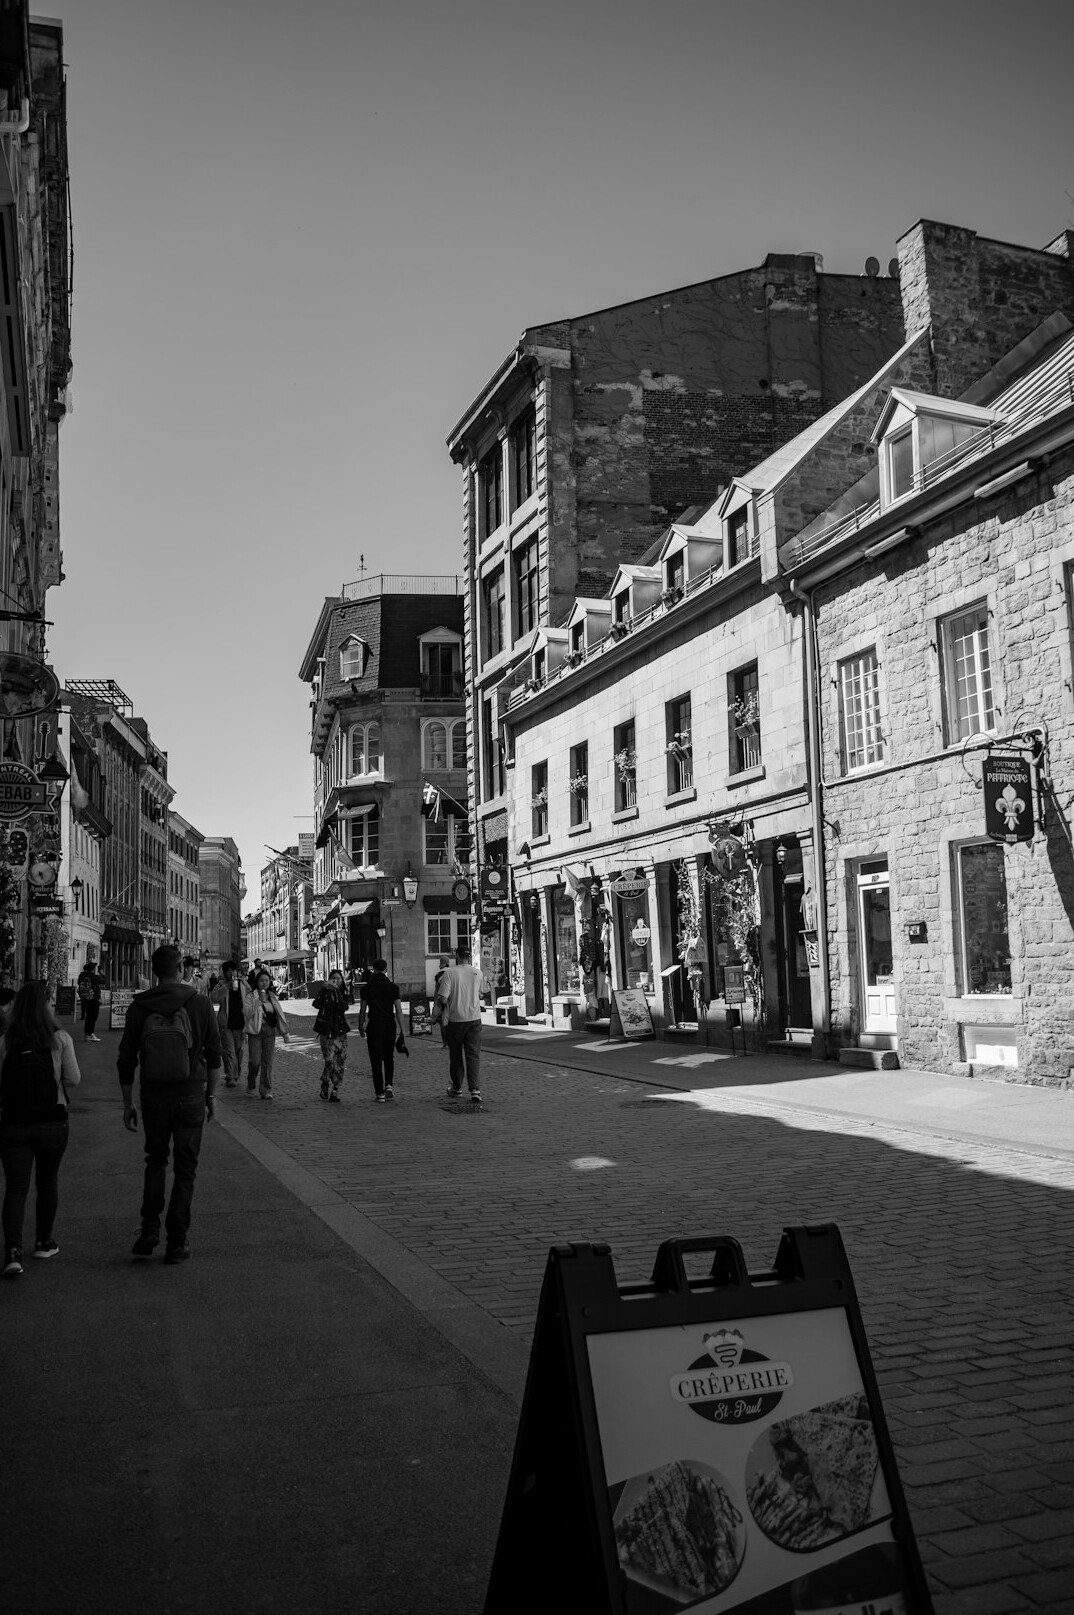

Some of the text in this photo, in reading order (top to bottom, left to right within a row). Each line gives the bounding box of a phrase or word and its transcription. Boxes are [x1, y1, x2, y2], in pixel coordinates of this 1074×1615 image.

[993, 761, 1021, 769] BOUTIQUE
[986, 773, 1029, 783] PATRIOTE
[613, 881, 648, 890] CRÊPERIE
[678, 1368, 789, 1399] CRÊPERIE
[714, 1397, 763, 1420] St-Paul
